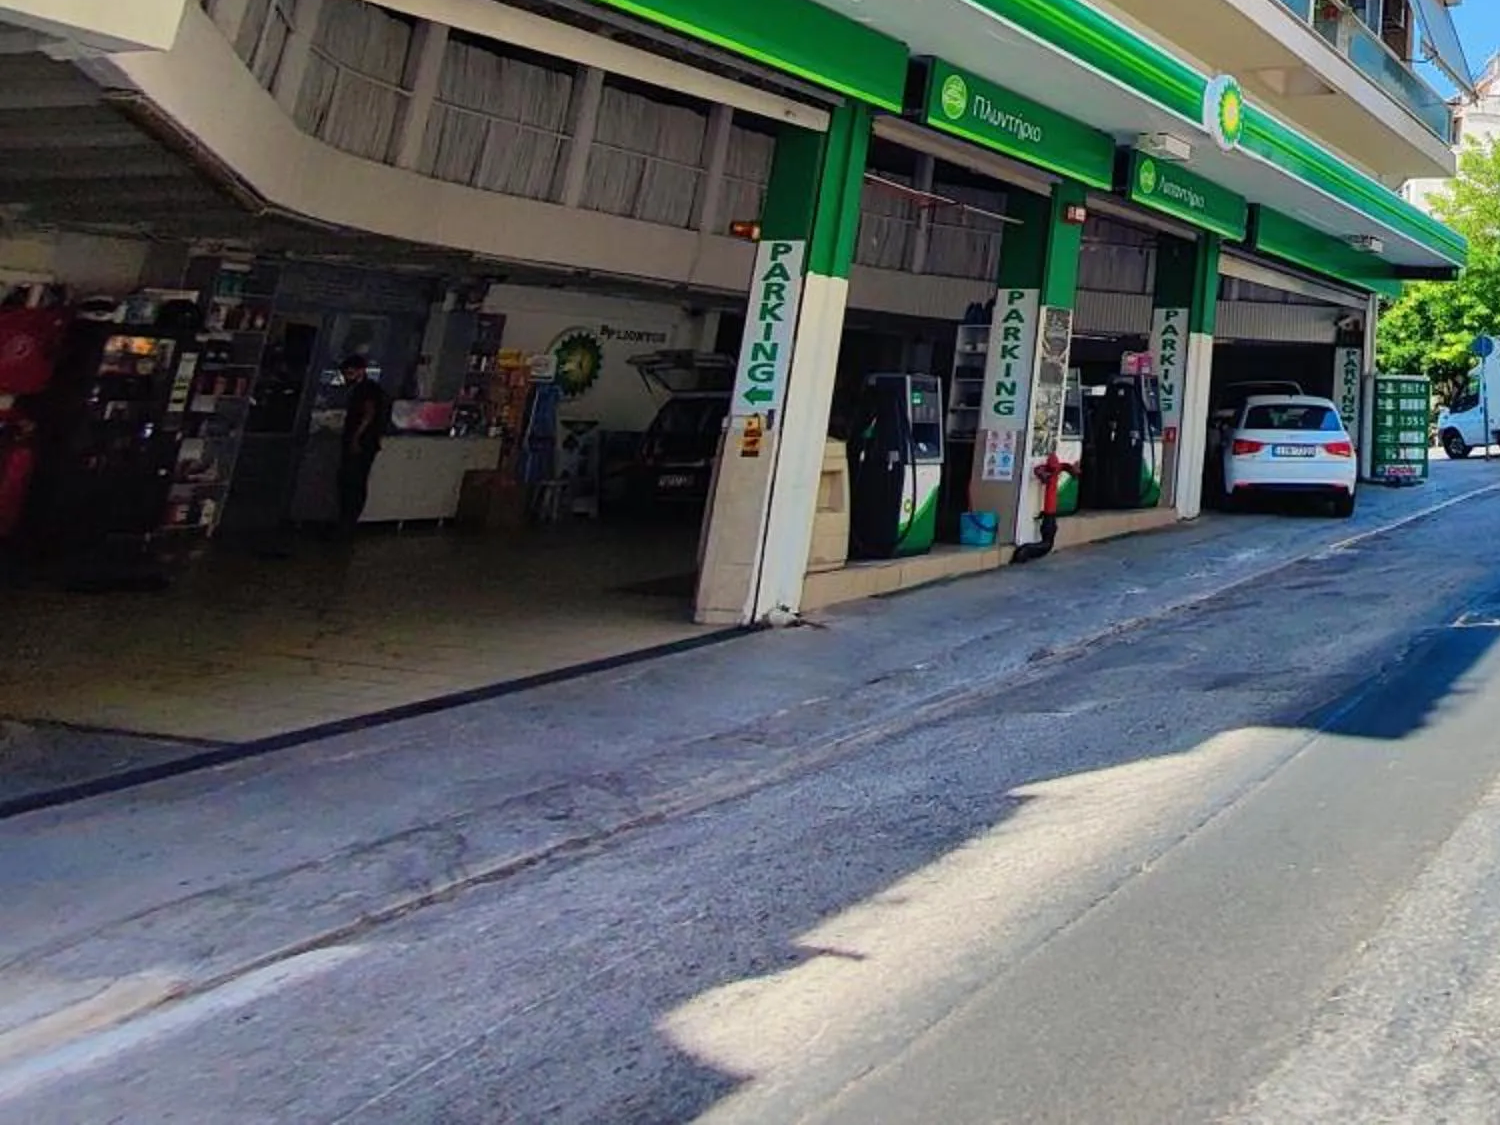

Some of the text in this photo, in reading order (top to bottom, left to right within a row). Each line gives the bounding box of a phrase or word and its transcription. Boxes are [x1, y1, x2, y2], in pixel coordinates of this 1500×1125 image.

[747, 242, 792, 383] PARKING
[993, 290, 1025, 416] PARKING
[1160, 310, 1178, 412] PARKING
